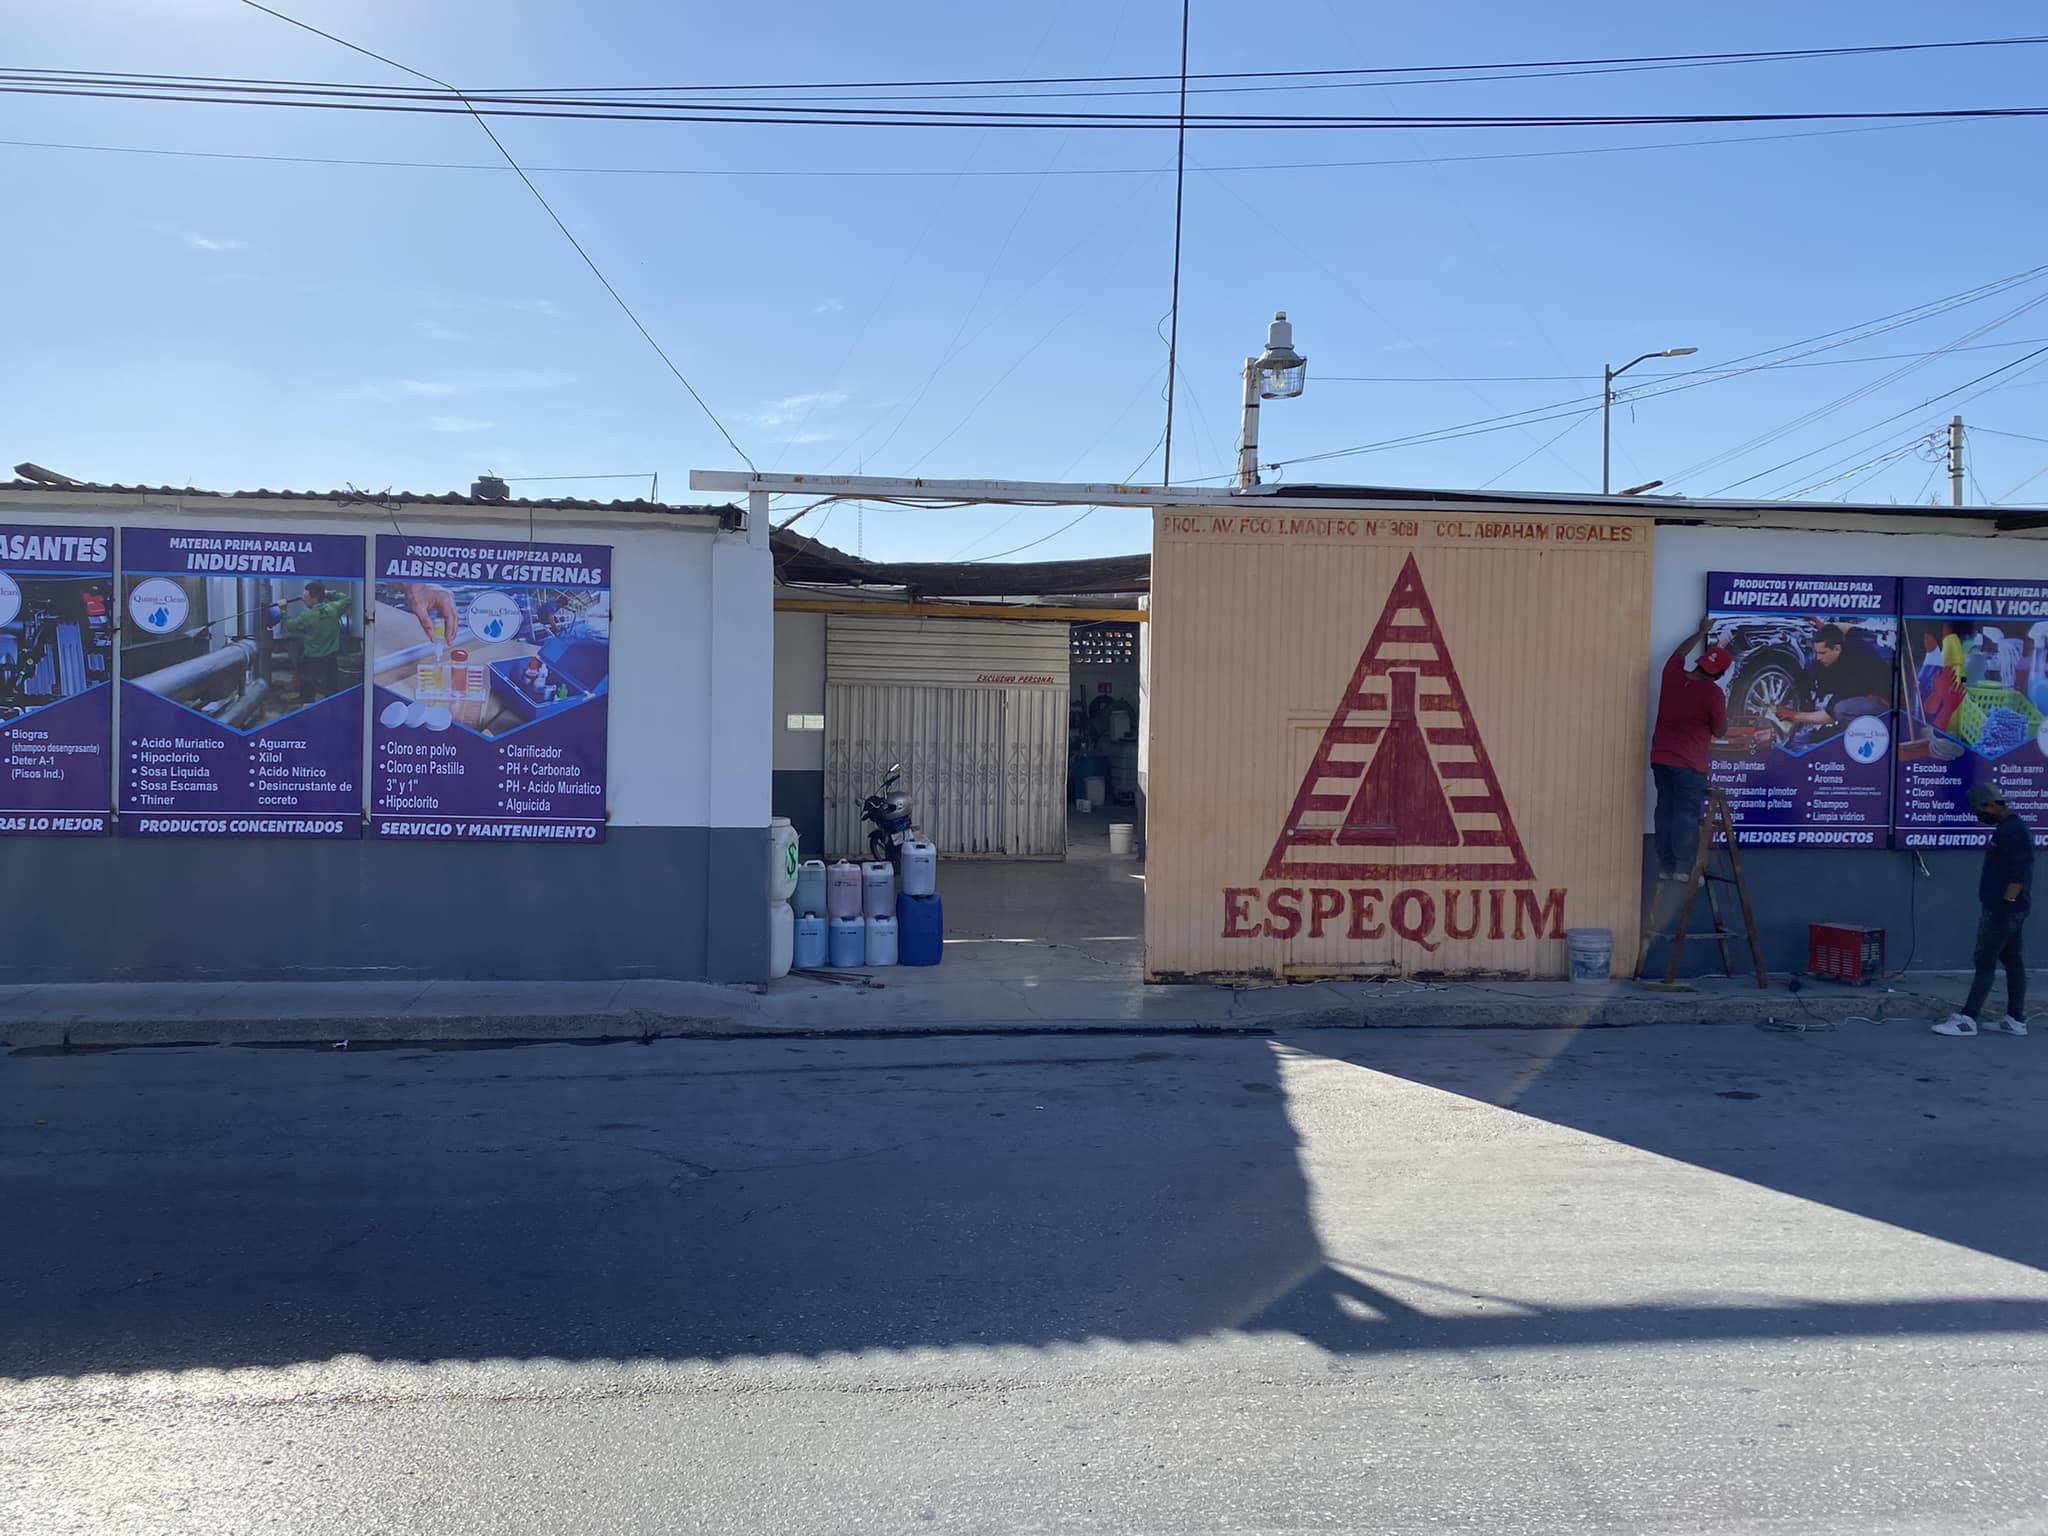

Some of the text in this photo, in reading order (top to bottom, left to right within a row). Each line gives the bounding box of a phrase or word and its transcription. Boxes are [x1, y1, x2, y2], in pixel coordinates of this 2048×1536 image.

[1475, 523, 1549, 539] ABRAHAM
[1555, 525, 1633, 542] ROSALES
[170, 537, 313, 553] MATERIA PRIMA PARA LA
[406, 545, 582, 564] PRODUCTOS DE LIMPIEZA PARA
[187, 552, 296, 573] INDUSTRIA
[386, 559, 602, 584] ALBERCAS Y CISTERNAS
[1733, 579, 1873, 592] PRODUCTOS Y MATERIALES PARA
[1927, 585, 1983, 596] PRODUCTOS
[1984, 586, 1998, 597] DE
[1999, 586, 2040, 598] LIMPIEZA
[1723, 591, 1882, 609] LIMPIEZA AUTOMOTRIZ
[1933, 598, 1993, 615] OFICINA
[1996, 599, 2008, 615] Y
[12, 729, 49, 741] Biogras
[140, 738, 225, 749] Acido Muriatico
[259, 738, 307, 751] Aguarraz
[387, 741, 457, 758] Cloro en polvo
[259, 752, 283, 763] Xilol
[507, 744, 562, 758] Clarificador
[12, 756, 55, 765] Deter A-1
[140, 752, 200, 764] Hipoclorito
[259, 766, 327, 777] Acido Nitrico
[386, 760, 465, 775] Cloro en Pastilla
[506, 762, 520, 775] PH
[531, 763, 581, 777] Carbonato
[1711, 760, 1732, 770] Brillo
[1814, 761, 1845, 773] Cepillos
[1913, 763, 1948, 773] Escobas
[2000, 764, 2044, 774] Quita sarro
[12, 769, 65, 780] (Pisos Ind.)
[140, 766, 210, 779] Sosa Liquida
[1711, 773, 1747, 783] Armor All
[1813, 774, 1844, 784] Aromas
[140, 780, 219, 791] Sosa Escamas
[259, 780, 353, 792] Desincrustante de
[506, 780, 520, 793] PH
[528, 781, 556, 793] Acido
[558, 781, 602, 795] Muriatico
[1912, 775, 1962, 787] Trapeadores
[2000, 776, 2033, 786] Guantes
[399, 782, 406, 795] y
[1912, 788, 1935, 797] Cloro
[140, 794, 175, 805] Thiner
[258, 796, 298, 805] cocreto
[386, 794, 439, 811] Hipoclorito
[506, 798, 551, 814] Alguicida
[1813, 799, 1849, 811] Shampoo
[1912, 800, 1955, 810] Pino Verde
[1813, 811, 1865, 823] Limpia vidrios
[1911, 812, 1937, 822] Aceite
[29, 818, 49, 830] LO
[52, 818, 103, 831] MEJOR
[139, 819, 344, 833] PRODUCTOS CONCENTRADOS
[380, 822, 597, 838] SERVICIO Y MANTENIMIENTO
[1738, 831, 1797, 844] MEJORES
[1798, 832, 1875, 844] PRODUCTOS
[1906, 834, 1986, 847] GRAN SURTIDO
[1221, 887, 1568, 952] ESPEQUIM
